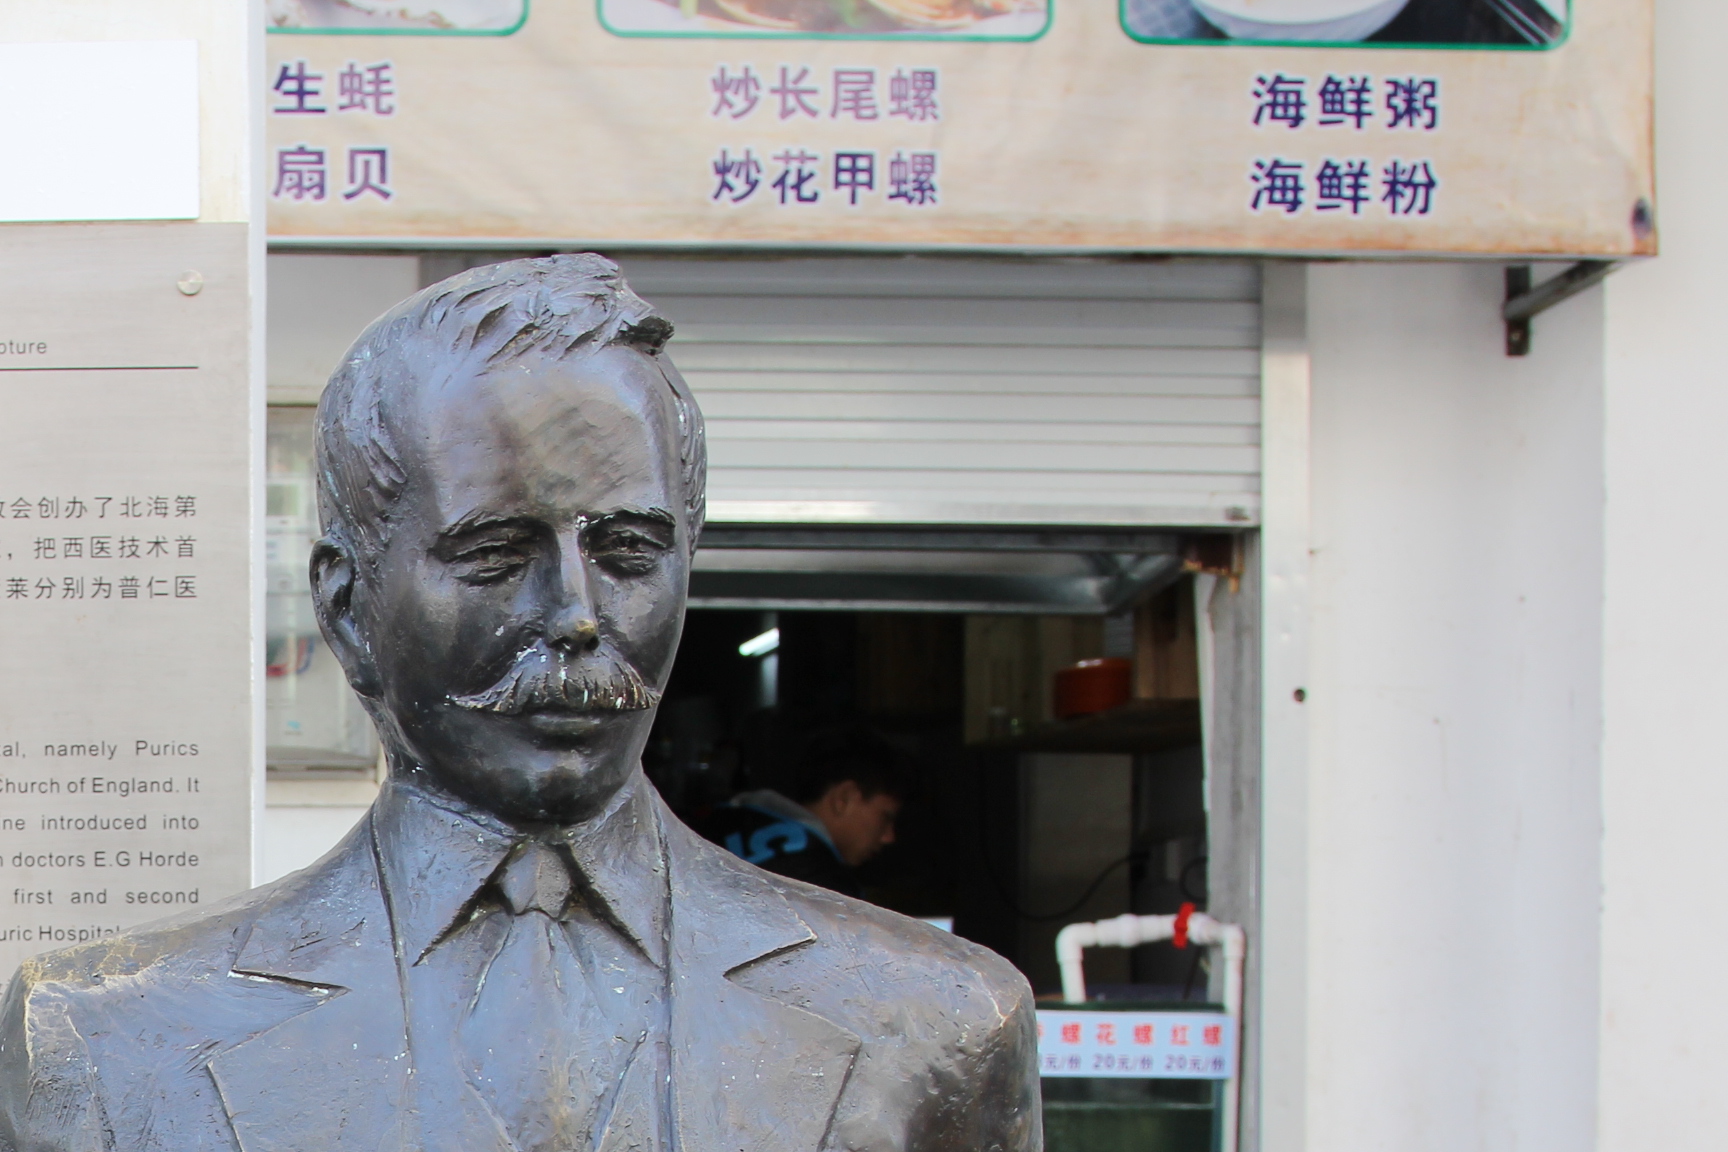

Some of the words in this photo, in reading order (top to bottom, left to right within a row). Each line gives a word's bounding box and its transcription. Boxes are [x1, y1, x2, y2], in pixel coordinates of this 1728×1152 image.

[272, 62, 395, 116] 生蚝
[711, 67, 940, 121] 炒长尾螺
[1252, 74, 1438, 130] 海鲜粥
[272, 145, 393, 201] 扇贝
[712, 149, 940, 205] 炒花甲螺
[1250, 159, 1437, 215] 海鲜粉
[45, 741, 117, 760] namely
[136, 740, 199, 756] Purics
[67, 777, 86, 793] of
[92, 777, 180, 797] England.
[188, 777, 199, 792] It
[42, 815, 146, 830] introduced
[163, 815, 199, 830] into
[12, 852, 85, 867] doctors
[94, 851, 130, 867] E.G
[140, 851, 199, 867] Horde
[14, 889, 53, 904] first
[71, 889, 106, 904] and
[126, 888, 199, 904] second
